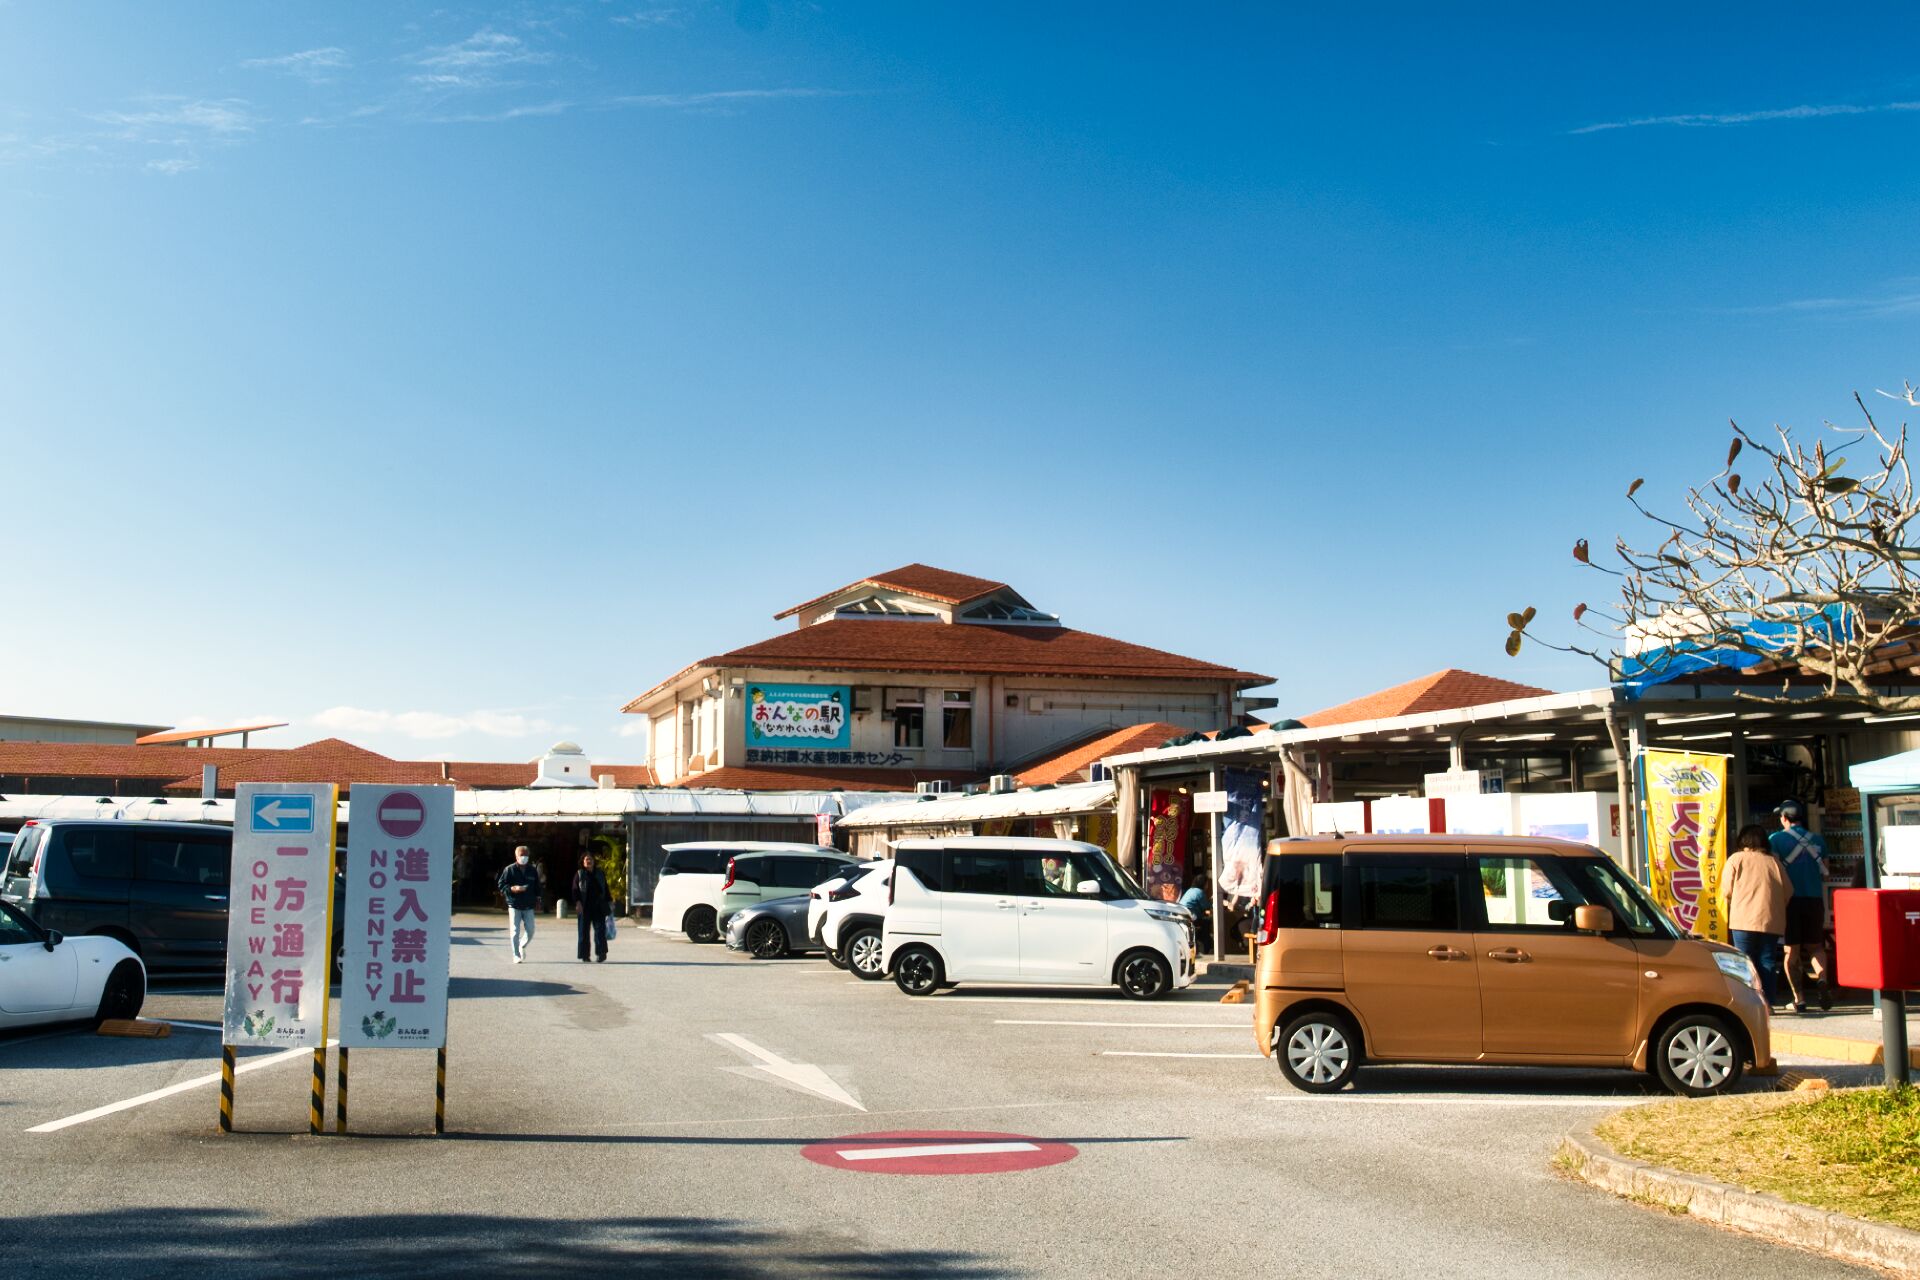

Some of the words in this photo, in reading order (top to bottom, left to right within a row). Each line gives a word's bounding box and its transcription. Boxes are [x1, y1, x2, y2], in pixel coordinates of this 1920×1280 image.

[756, 704, 841, 723] おんなの駅
[251, 860, 268, 924] ONE
[369, 850, 387, 889] NO
[270, 847, 309, 1004] 一方通行
[366, 897, 385, 1001] ENTRY
[390, 848, 430, 1003] 進入禁止
[247, 936, 266, 1001] WAY
